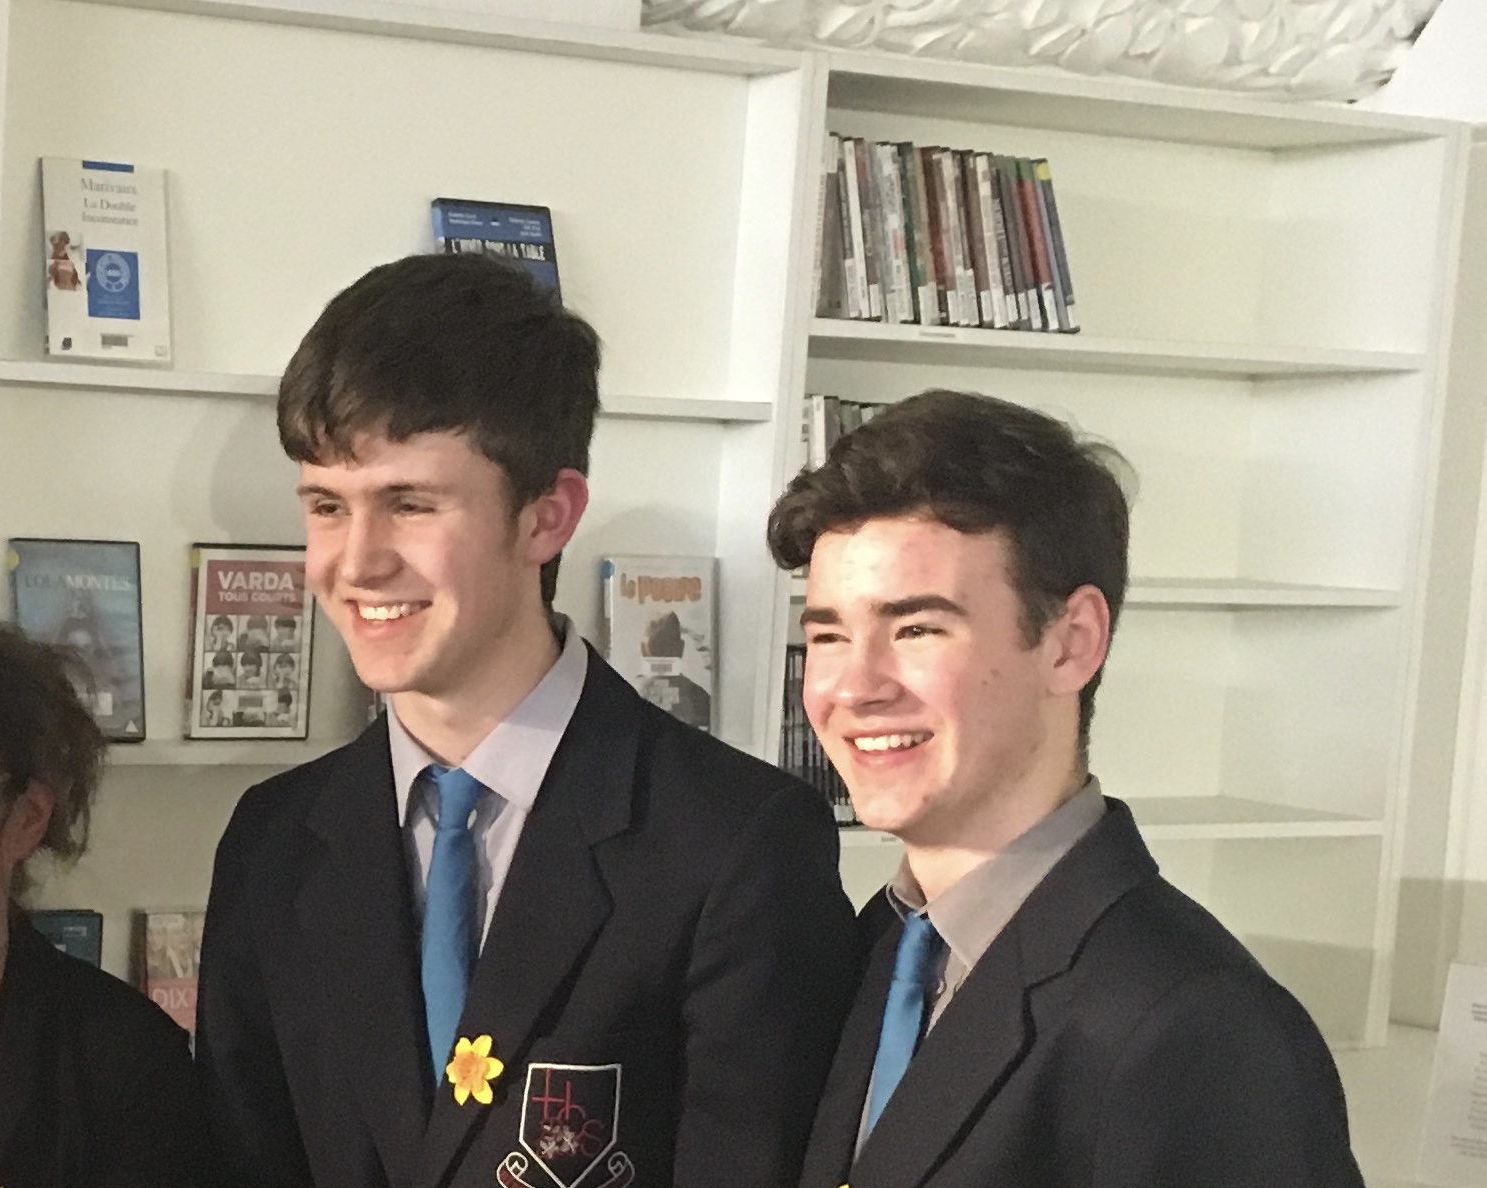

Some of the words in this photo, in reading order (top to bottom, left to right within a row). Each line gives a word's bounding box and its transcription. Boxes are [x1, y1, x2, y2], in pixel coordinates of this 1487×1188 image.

[80, 177, 138, 196] Marivaux
[84, 198, 97, 210] La
[100, 199, 136, 212] Double
[81, 211, 139, 226] Inconstance
[217, 570, 295, 591] VARDA
[218, 591, 250, 602] TOUS
[251, 592, 297, 603] COURTS
